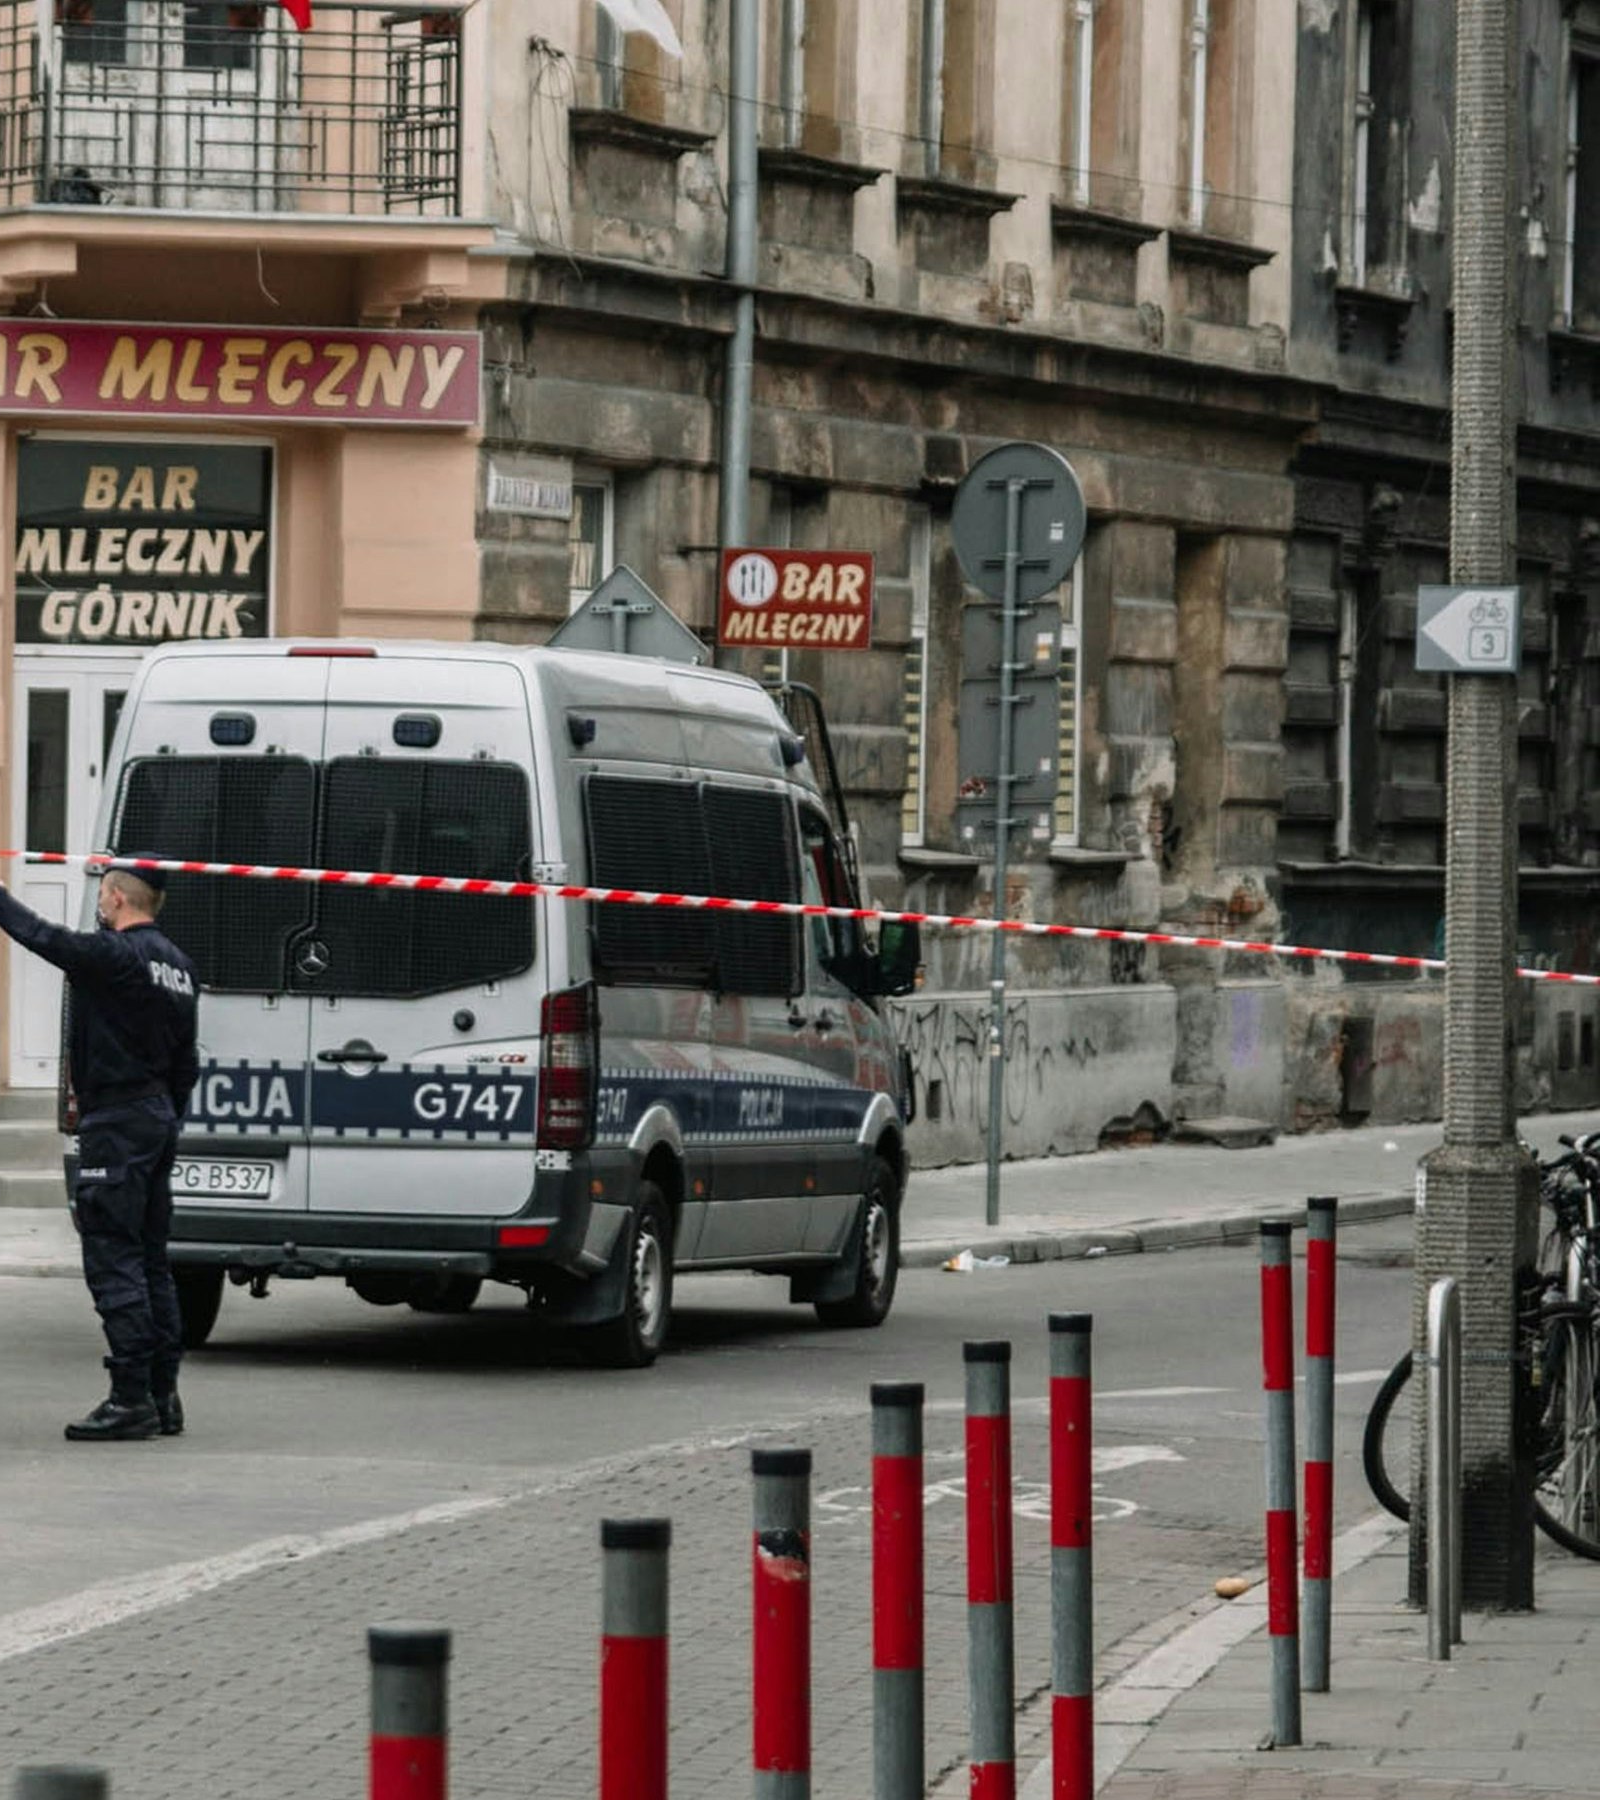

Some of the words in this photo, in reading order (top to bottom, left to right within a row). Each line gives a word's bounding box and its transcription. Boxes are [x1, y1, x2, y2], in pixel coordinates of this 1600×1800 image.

[99, 335, 464, 410] MLECZNY
[82, 465, 199, 511] BAR
[16, 527, 265, 574] MLECZNY
[781, 561, 865, 605] BAR
[40, 583, 248, 638] GÓRNIK
[724, 611, 865, 642] MLECZNY
[1481, 632, 1495, 654] 3
[191, 1073, 293, 1118] ICJA
[413, 1083, 524, 1121] G747
[209, 1165, 267, 1191] B537
